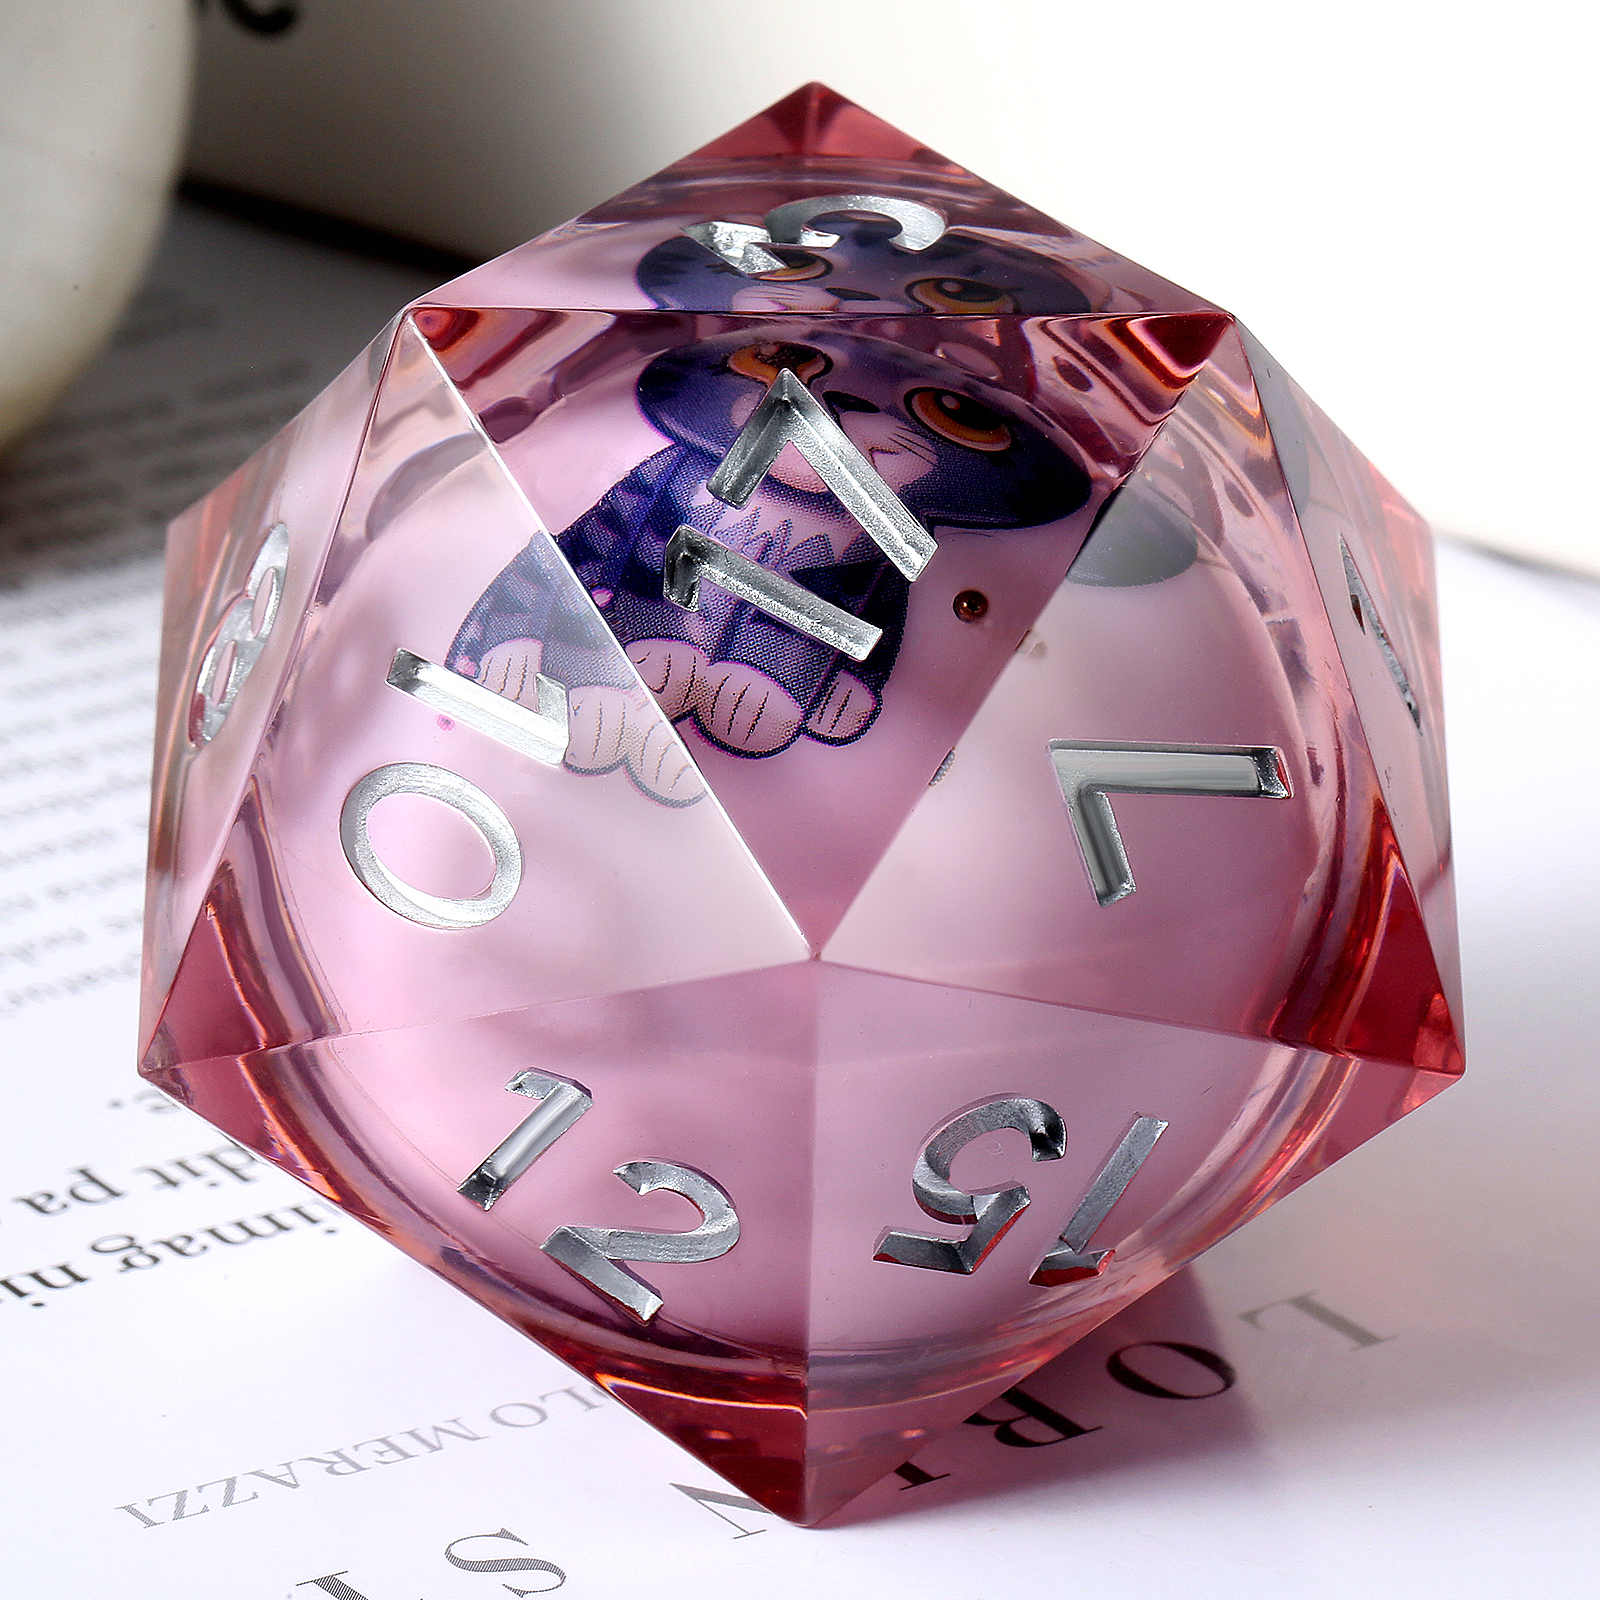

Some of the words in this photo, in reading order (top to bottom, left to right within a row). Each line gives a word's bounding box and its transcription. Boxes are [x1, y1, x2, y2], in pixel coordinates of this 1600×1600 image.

[663, 368, 939, 662] 17
[188, 522, 289, 748] 8
[340, 648, 571, 930] 10
[1046, 738, 1294, 907] 7
[12, 1164, 127, 1216] pa
[89, 1199, 343, 1273] imag
[456, 1067, 741, 1325] 12
[873, 1093, 1169, 1288] 15
[115, 1416, 489, 1528] MERAZZI
